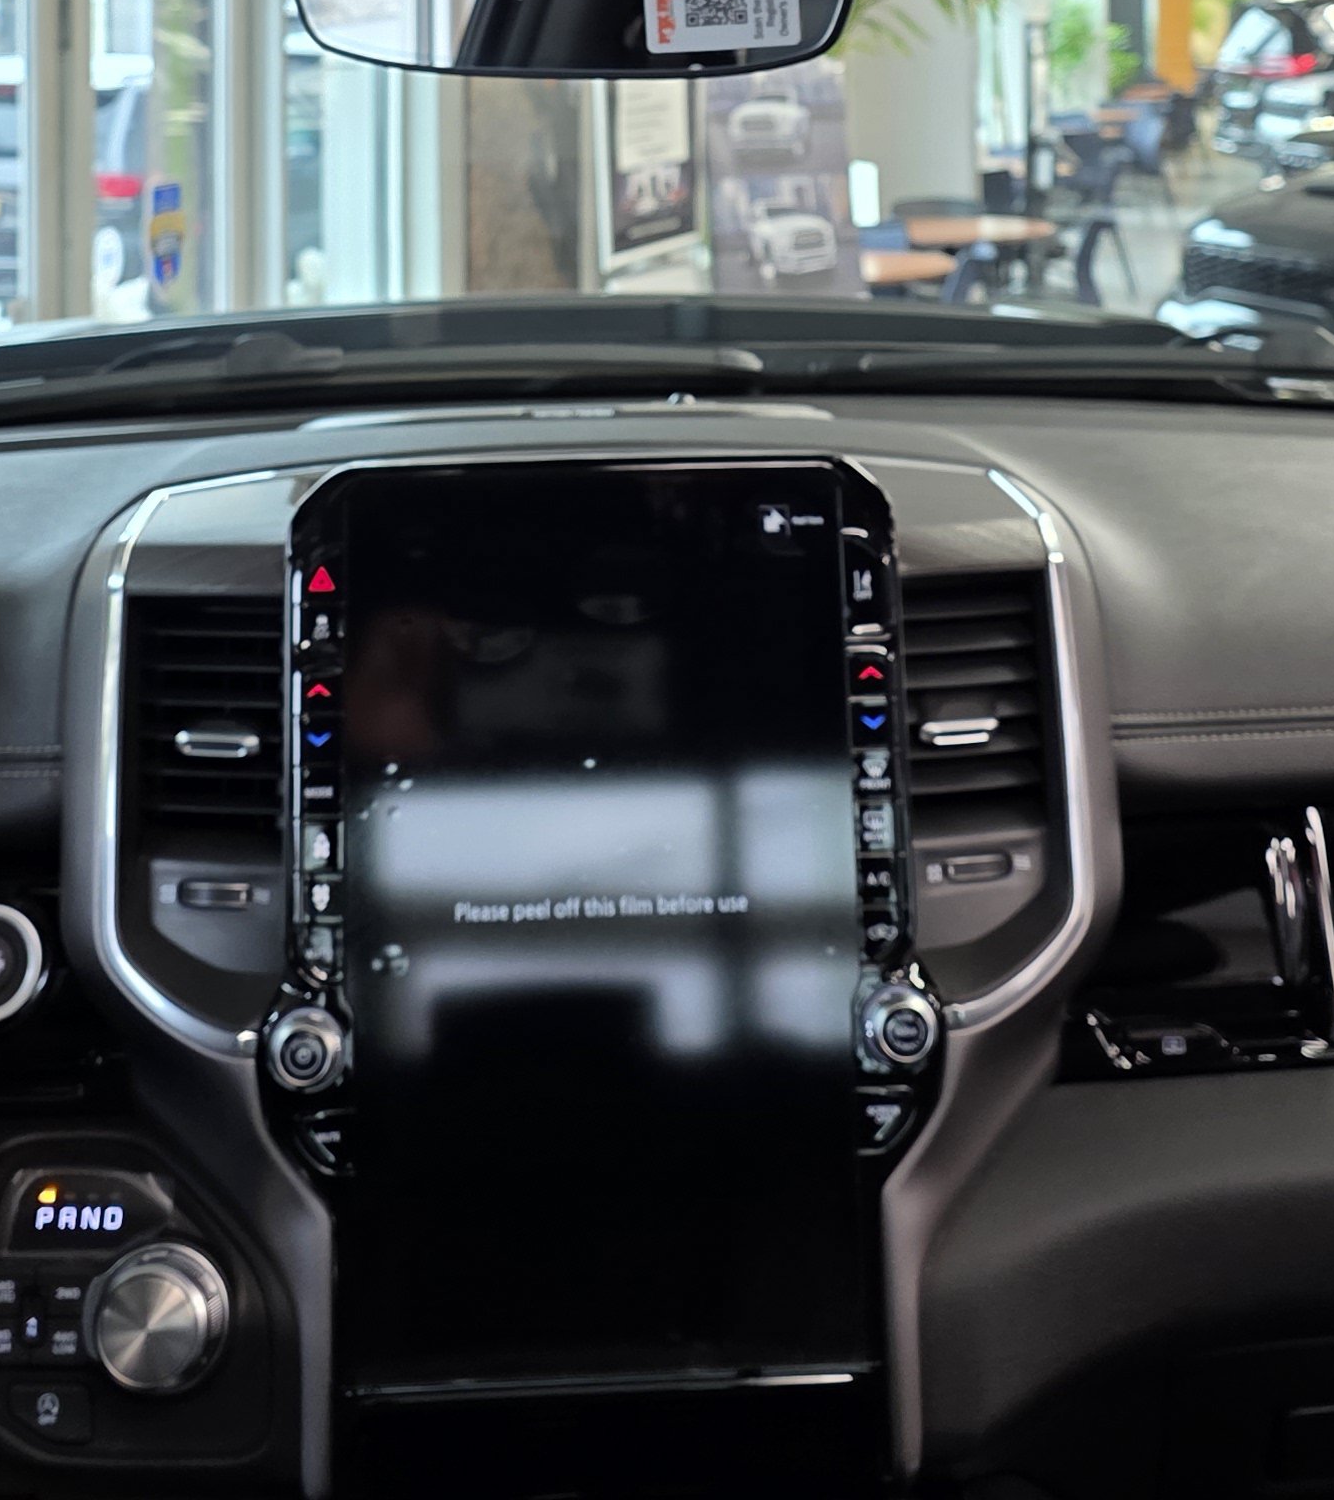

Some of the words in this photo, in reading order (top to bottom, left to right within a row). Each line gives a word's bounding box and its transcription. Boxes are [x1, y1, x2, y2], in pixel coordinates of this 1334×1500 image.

[753, 0, 763, 15] the
[778, 1, 789, 37] Owner's
[753, 16, 764, 40] Scan
[454, 902, 509, 922] Please
[512, 898, 551, 923] peel
[553, 896, 581, 920] off
[583, 896, 616, 918] this
[619, 895, 653, 916] film
[656, 894, 715, 916] before
[717, 896, 748, 914] use
